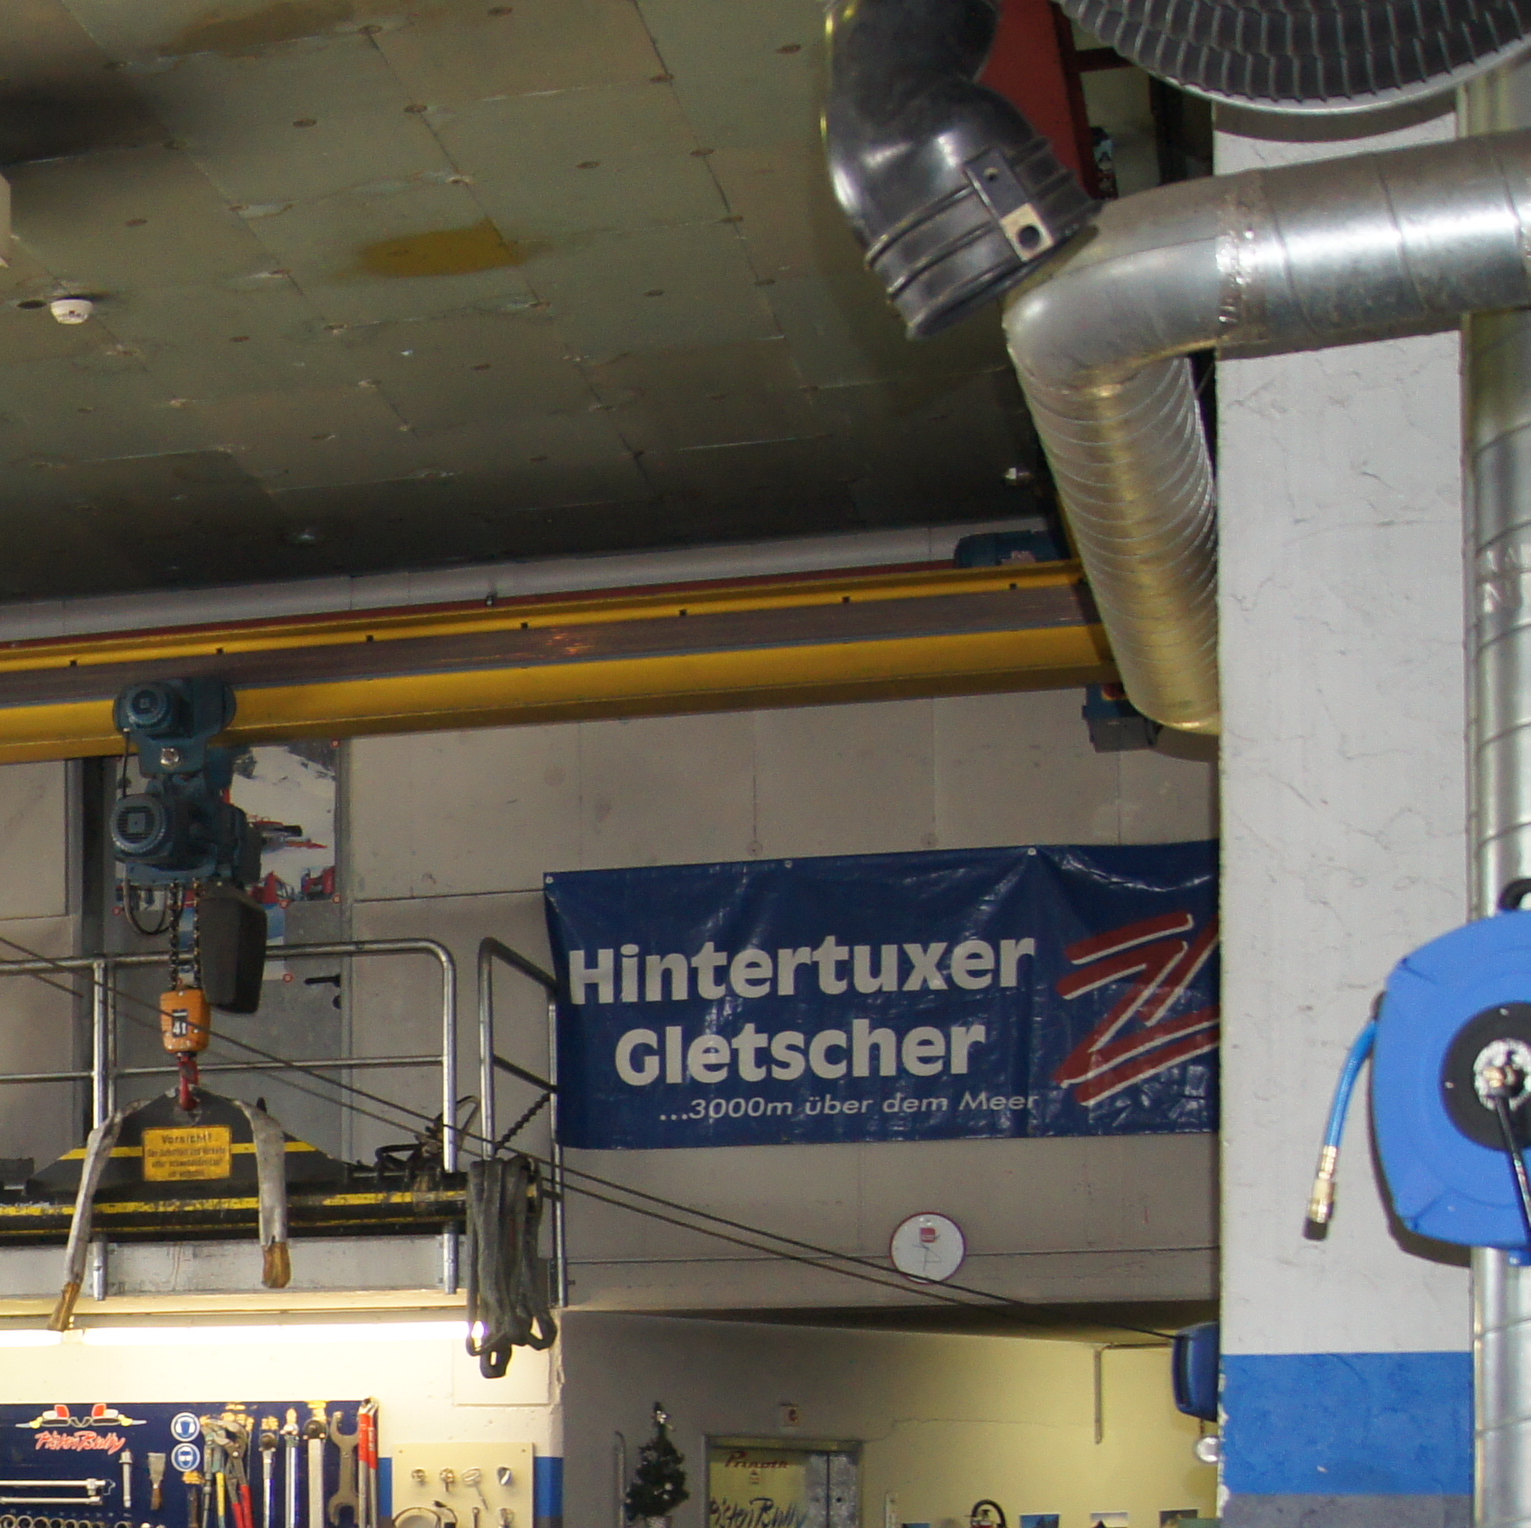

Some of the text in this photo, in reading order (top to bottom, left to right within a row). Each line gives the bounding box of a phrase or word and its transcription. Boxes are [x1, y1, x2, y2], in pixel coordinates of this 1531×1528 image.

[569, 935, 1035, 1005] Hintertuxer
[615, 1018, 986, 1086] Gletscher
[660, 1091, 1040, 1122] ...3000m über dem Meer
